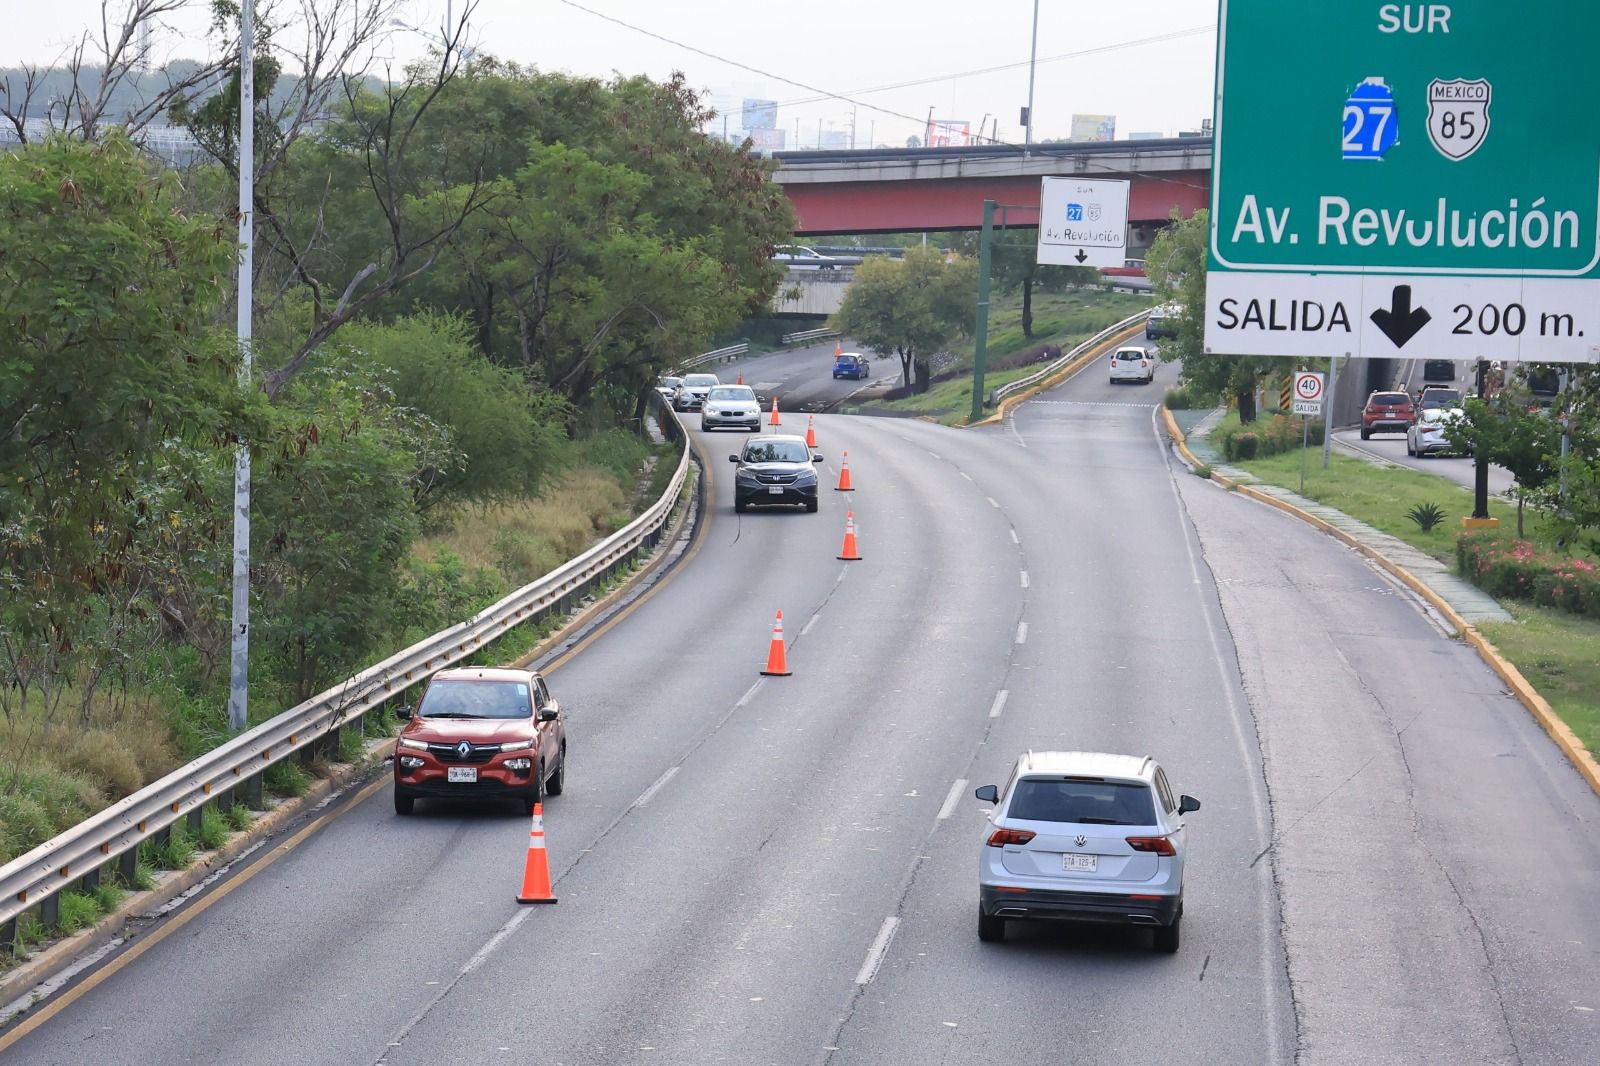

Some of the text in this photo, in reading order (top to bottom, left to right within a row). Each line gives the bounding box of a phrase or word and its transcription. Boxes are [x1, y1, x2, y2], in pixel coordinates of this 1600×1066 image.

[1377, 4, 1452, 34] SUR
[1435, 86, 1484, 98] MEXICO
[1342, 105, 1392, 152] 27
[1441, 111, 1475, 140] 85
[1068, 208, 1082, 220] 27
[1231, 194, 1579, 248] Av. Revolución
[1216, 298, 1352, 333] SALIDA
[1451, 303, 1585, 337] 200 m.
[1302, 380, 1316, 391] 40
[1295, 403, 1319, 412] SALIDA
